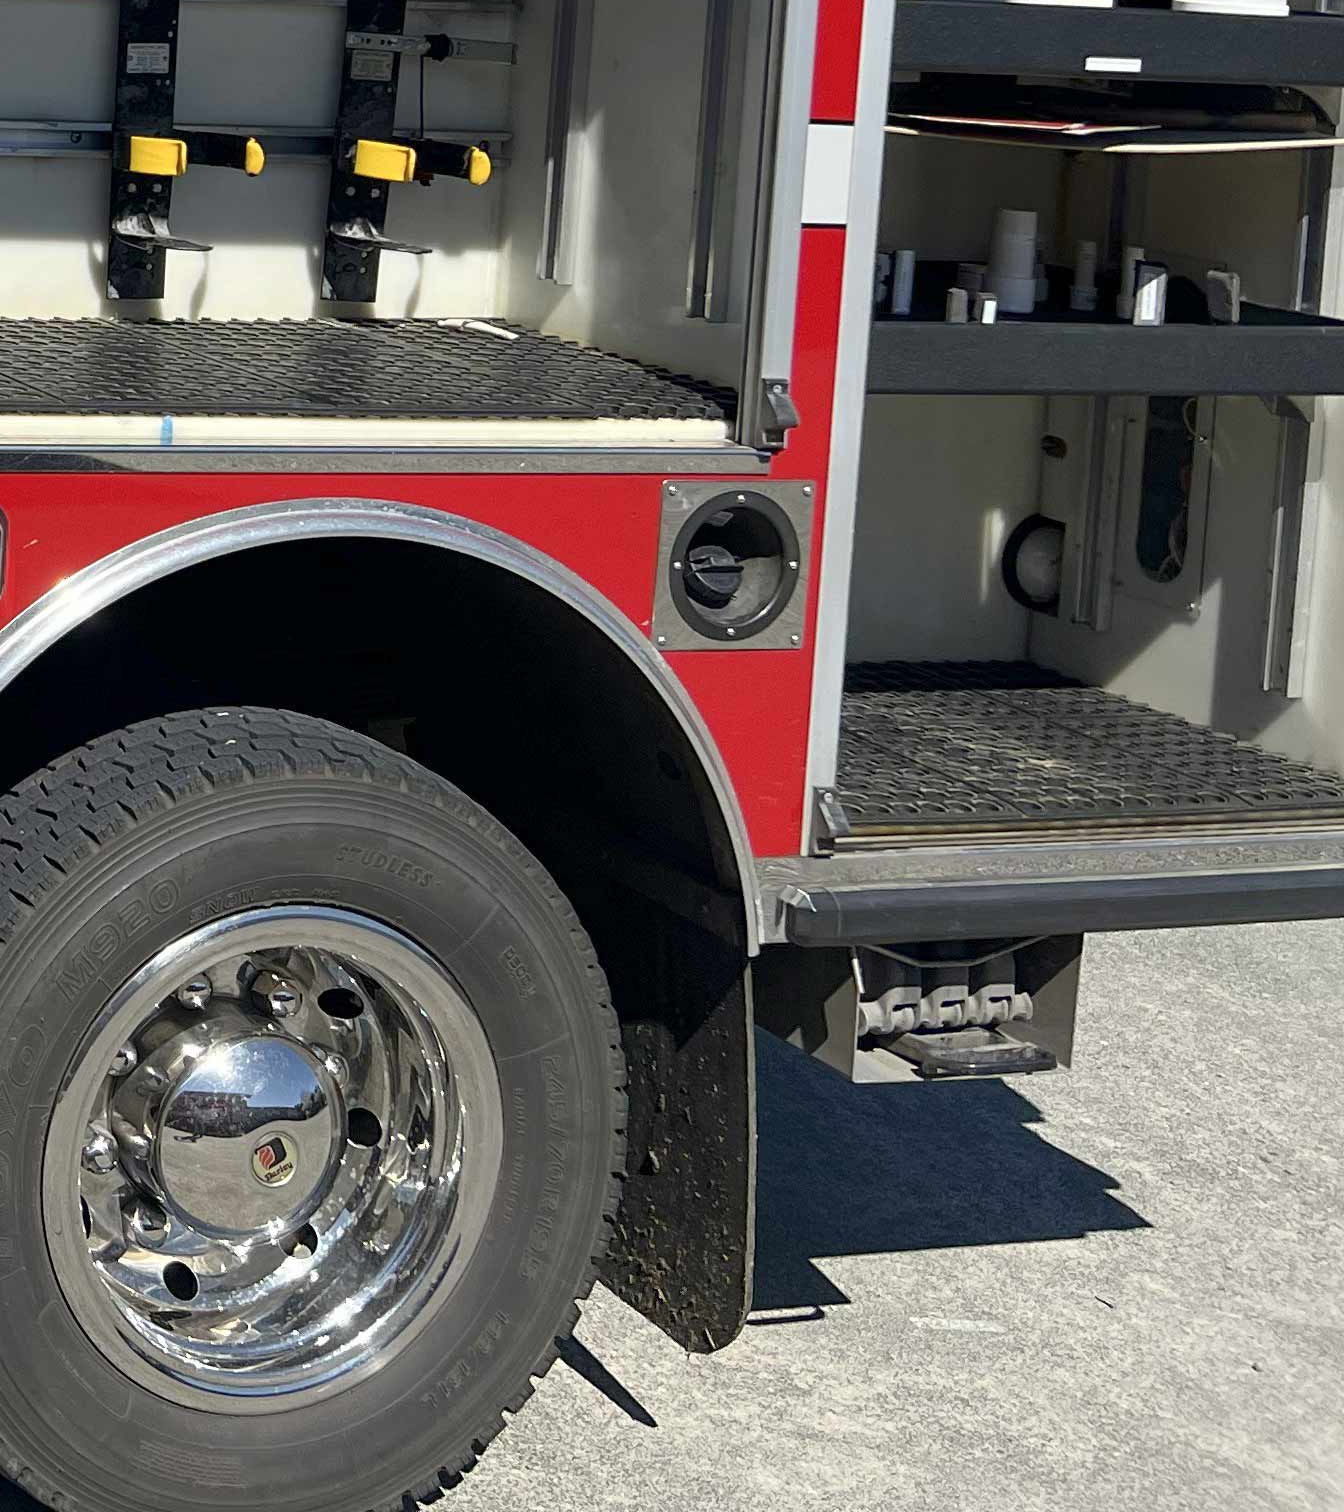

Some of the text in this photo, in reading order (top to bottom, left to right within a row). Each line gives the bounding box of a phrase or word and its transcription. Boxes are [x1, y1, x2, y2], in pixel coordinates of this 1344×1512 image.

[335, 845, 434, 888] STUDLESS
[56, 877, 181, 1004] M920
[264, 1161, 293, 1181] Darley
